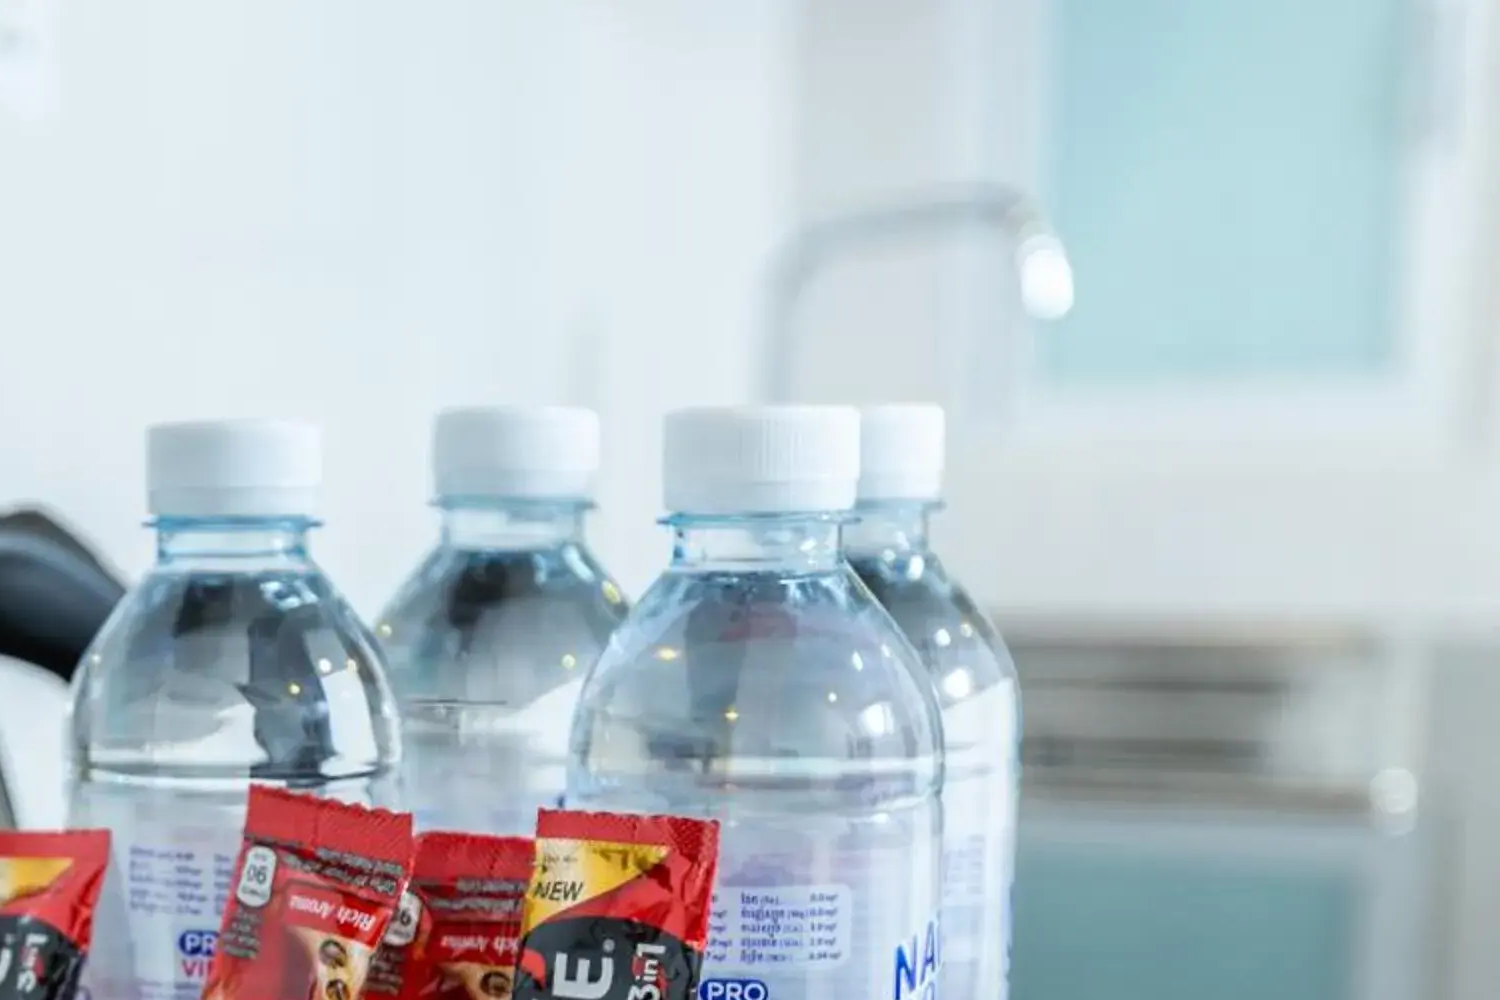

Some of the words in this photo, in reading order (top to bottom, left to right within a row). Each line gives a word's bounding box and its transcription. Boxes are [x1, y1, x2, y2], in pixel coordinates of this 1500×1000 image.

[532, 880, 584, 902] NEW
[336, 906, 376, 932] Rich
[184, 933, 218, 955] PR
